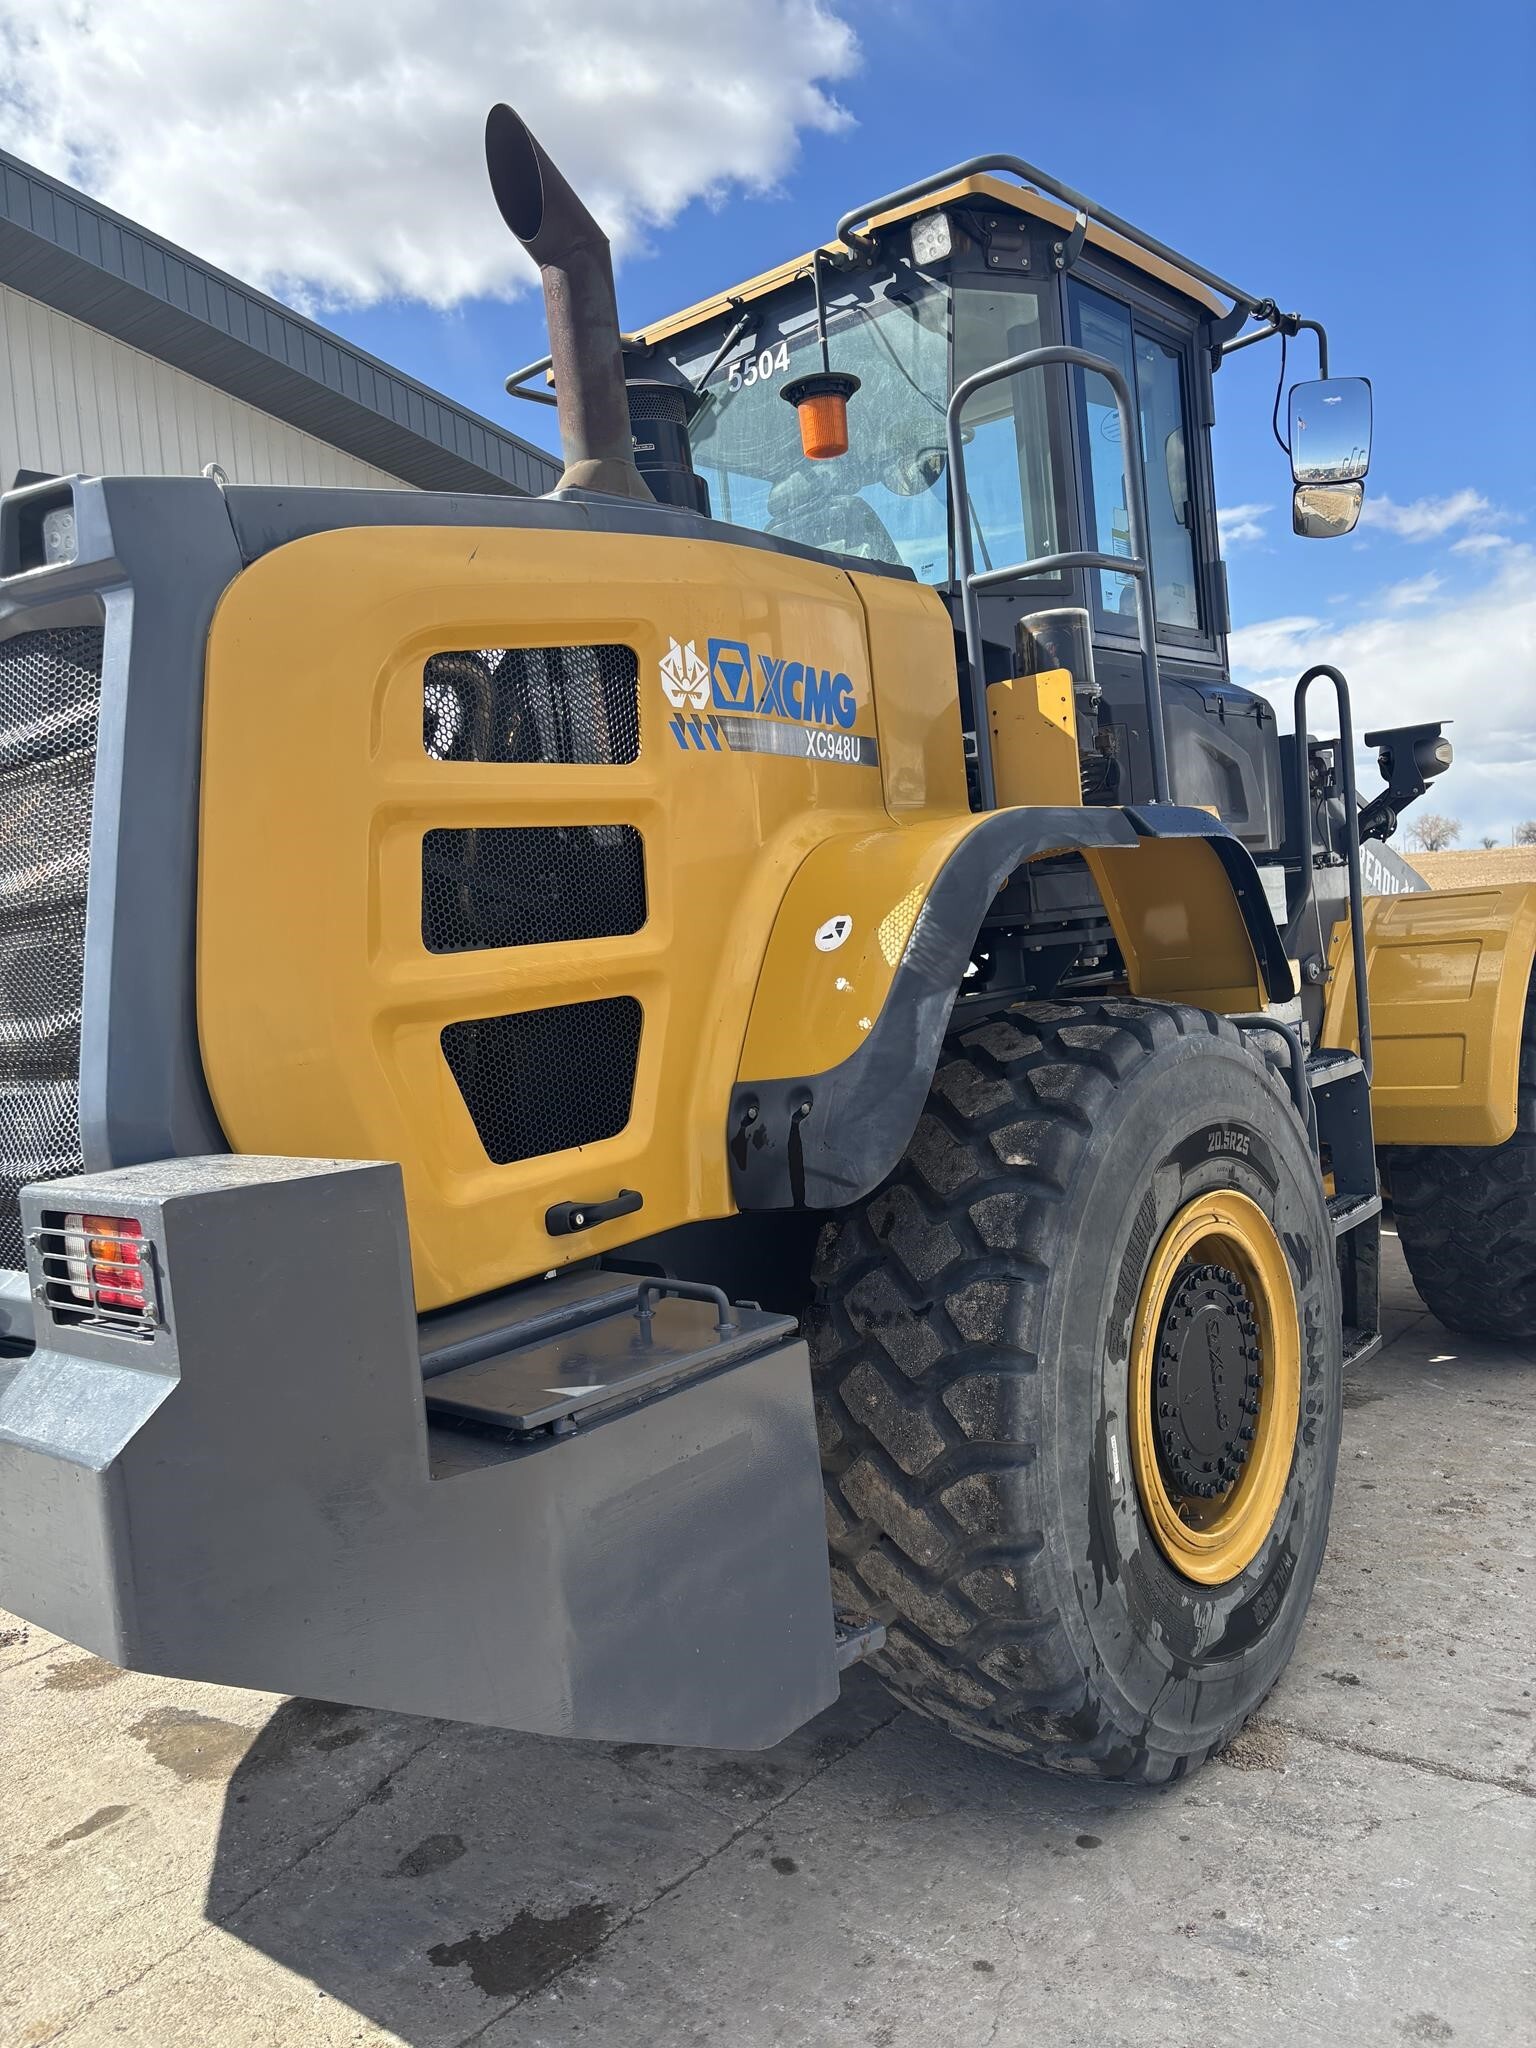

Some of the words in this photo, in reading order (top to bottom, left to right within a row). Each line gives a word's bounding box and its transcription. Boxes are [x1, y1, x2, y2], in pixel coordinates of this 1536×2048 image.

[729, 343, 790, 392] 5504
[757, 654, 856, 729] XCMG
[806, 730, 861, 762] XC948U
[1207, 1130, 1250, 1156] 20.5R25
